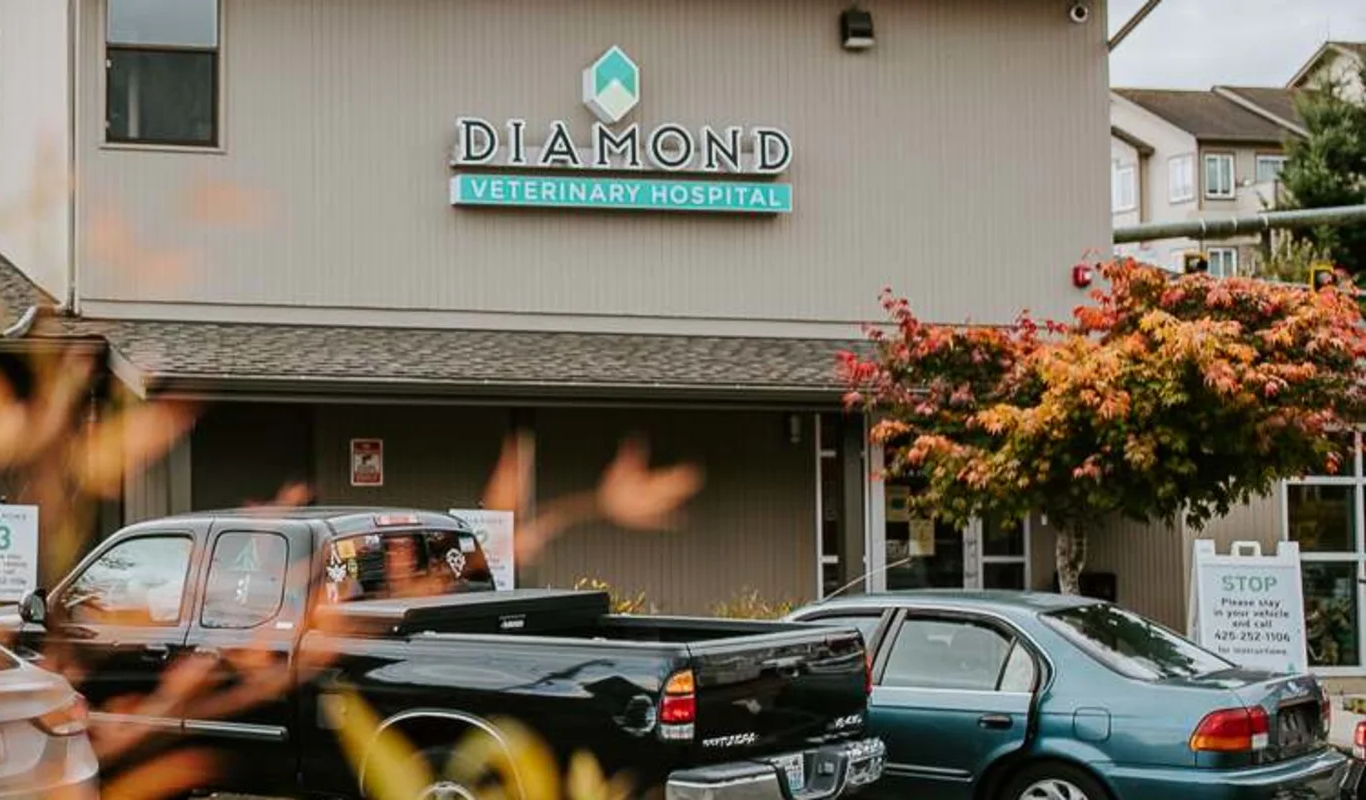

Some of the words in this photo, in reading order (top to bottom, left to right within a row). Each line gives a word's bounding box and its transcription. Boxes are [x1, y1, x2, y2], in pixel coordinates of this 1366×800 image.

[459, 119, 792, 171] DIAMOND
[471, 179, 645, 203] VETERINARY
[652, 183, 782, 207] HOSPITAL
[1221, 575, 1278, 593] STOP
[1221, 597, 1255, 607] Please
[1258, 598, 1281, 608] stay
[1227, 610, 1249, 618] your
[1253, 610, 1290, 618] vehicle
[1232, 620, 1250, 628] and
[1254, 620, 1273, 628] call
